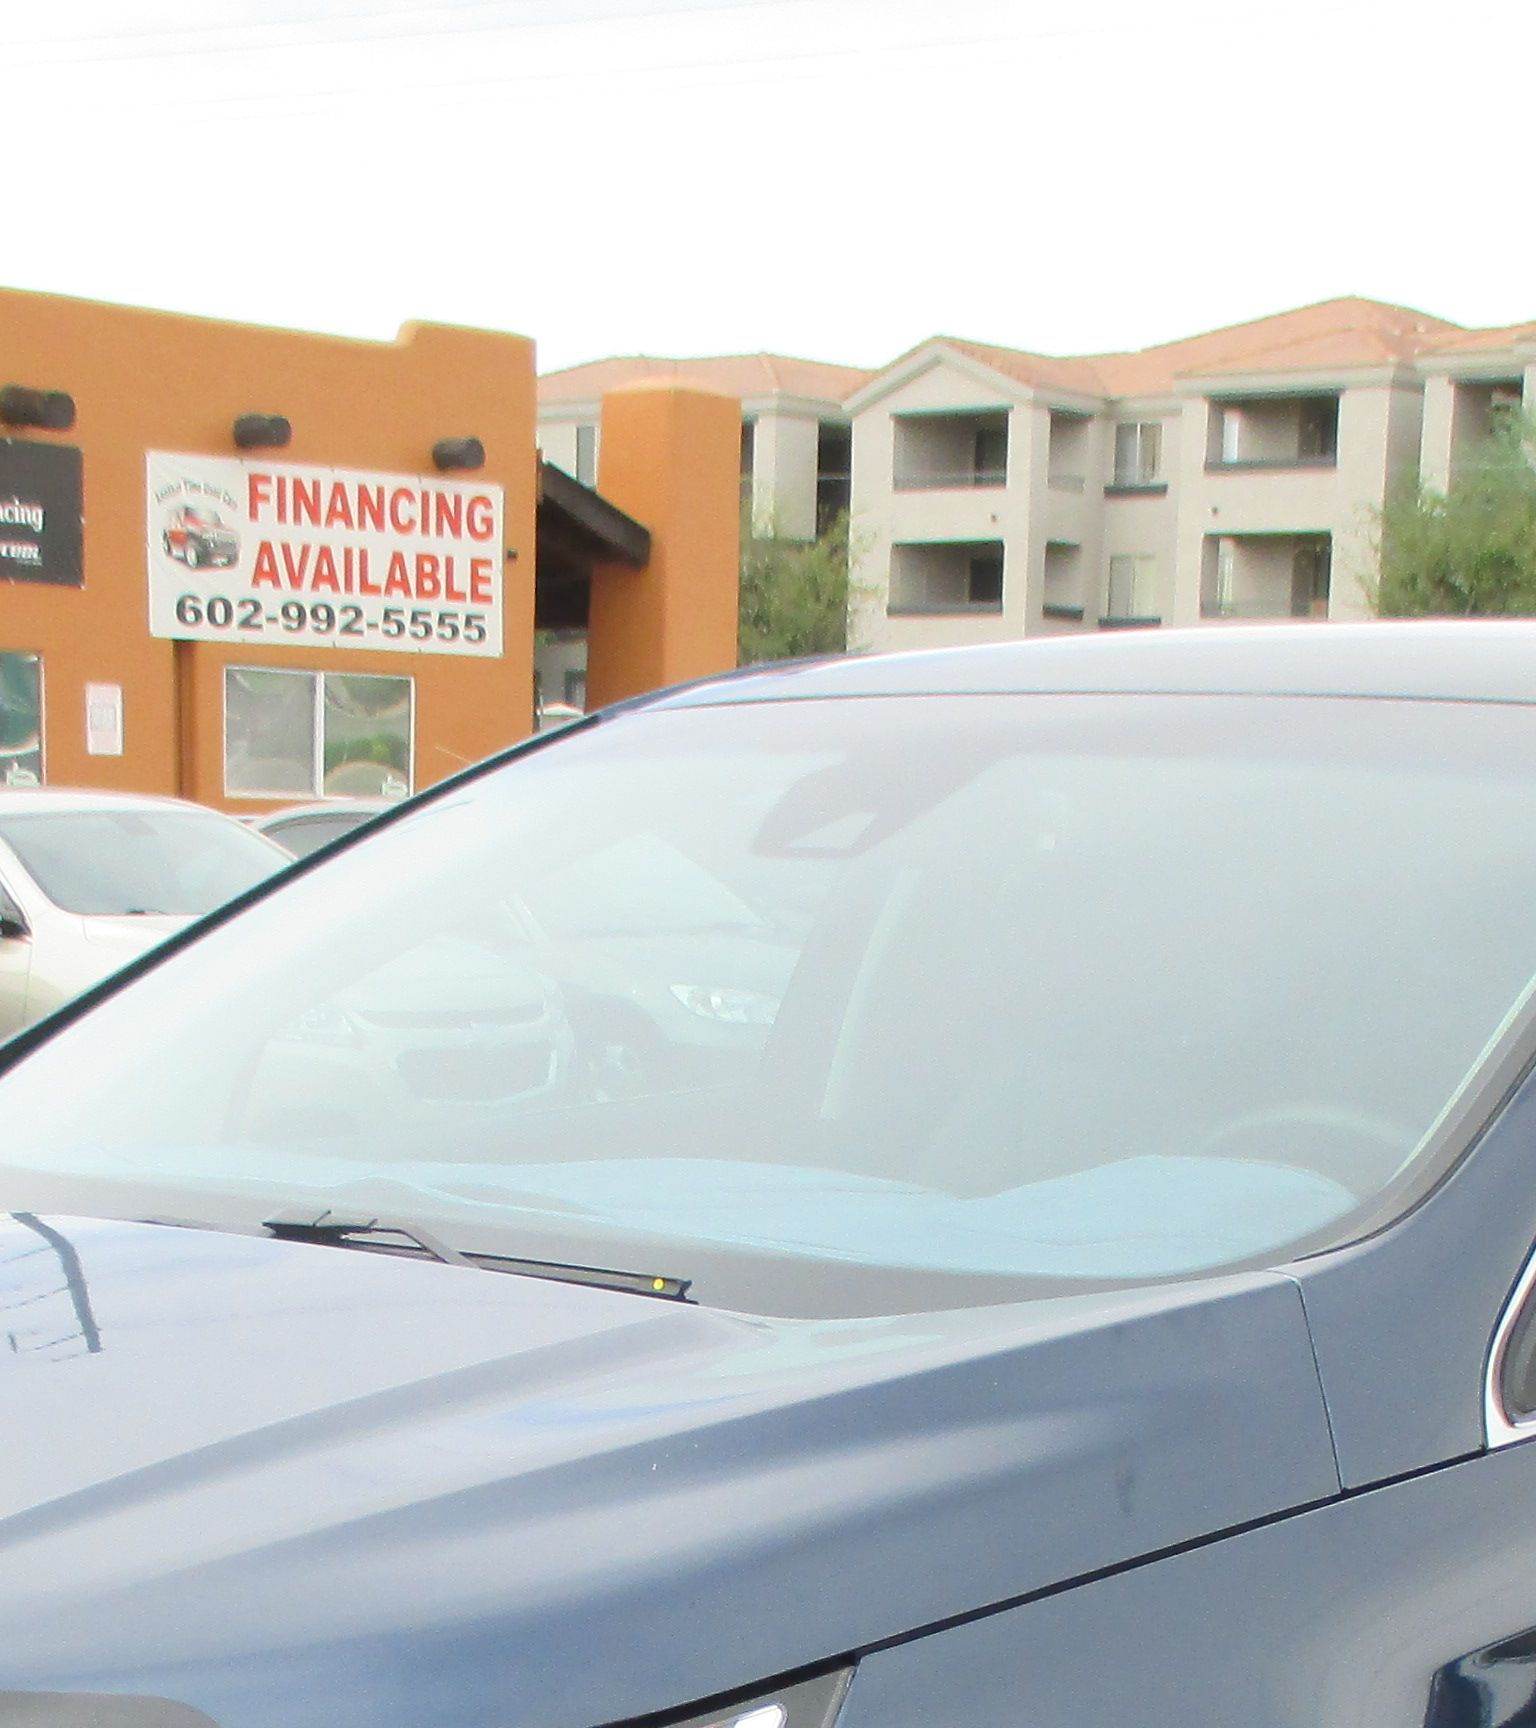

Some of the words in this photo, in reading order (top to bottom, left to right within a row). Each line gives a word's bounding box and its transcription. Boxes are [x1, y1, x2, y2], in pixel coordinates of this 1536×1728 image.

[247, 471, 495, 543] FINANCING
[250, 539, 494, 605] AVAILABLE
[175, 594, 488, 645] 602-992-5555
